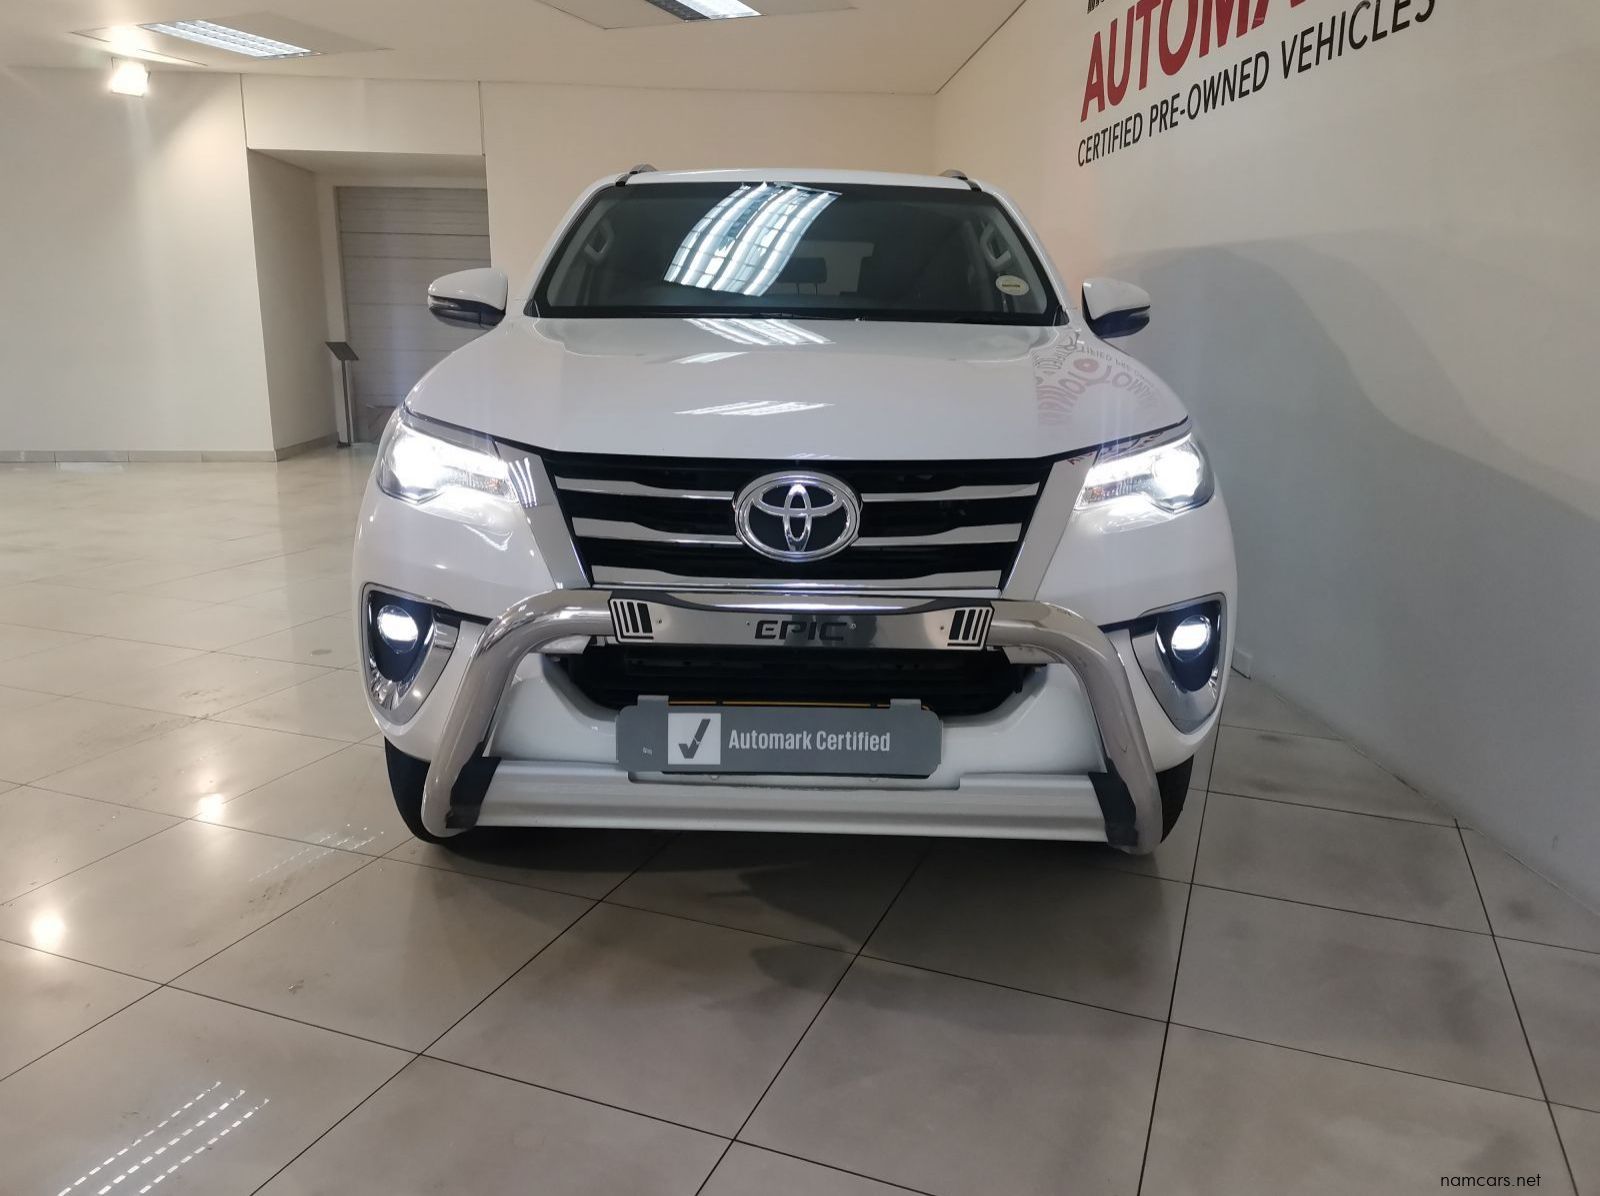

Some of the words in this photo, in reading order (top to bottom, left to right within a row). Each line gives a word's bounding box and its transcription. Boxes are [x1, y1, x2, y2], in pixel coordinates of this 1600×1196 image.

[1081, 0, 1309, 122] AUTO
[1078, 112, 1143, 167] CERTIFIED
[1149, 51, 1269, 138] PRE-OWNED
[754, 620, 847, 641] EPIC
[728, 729, 812, 750] Automark
[816, 730, 891, 752] Certified
